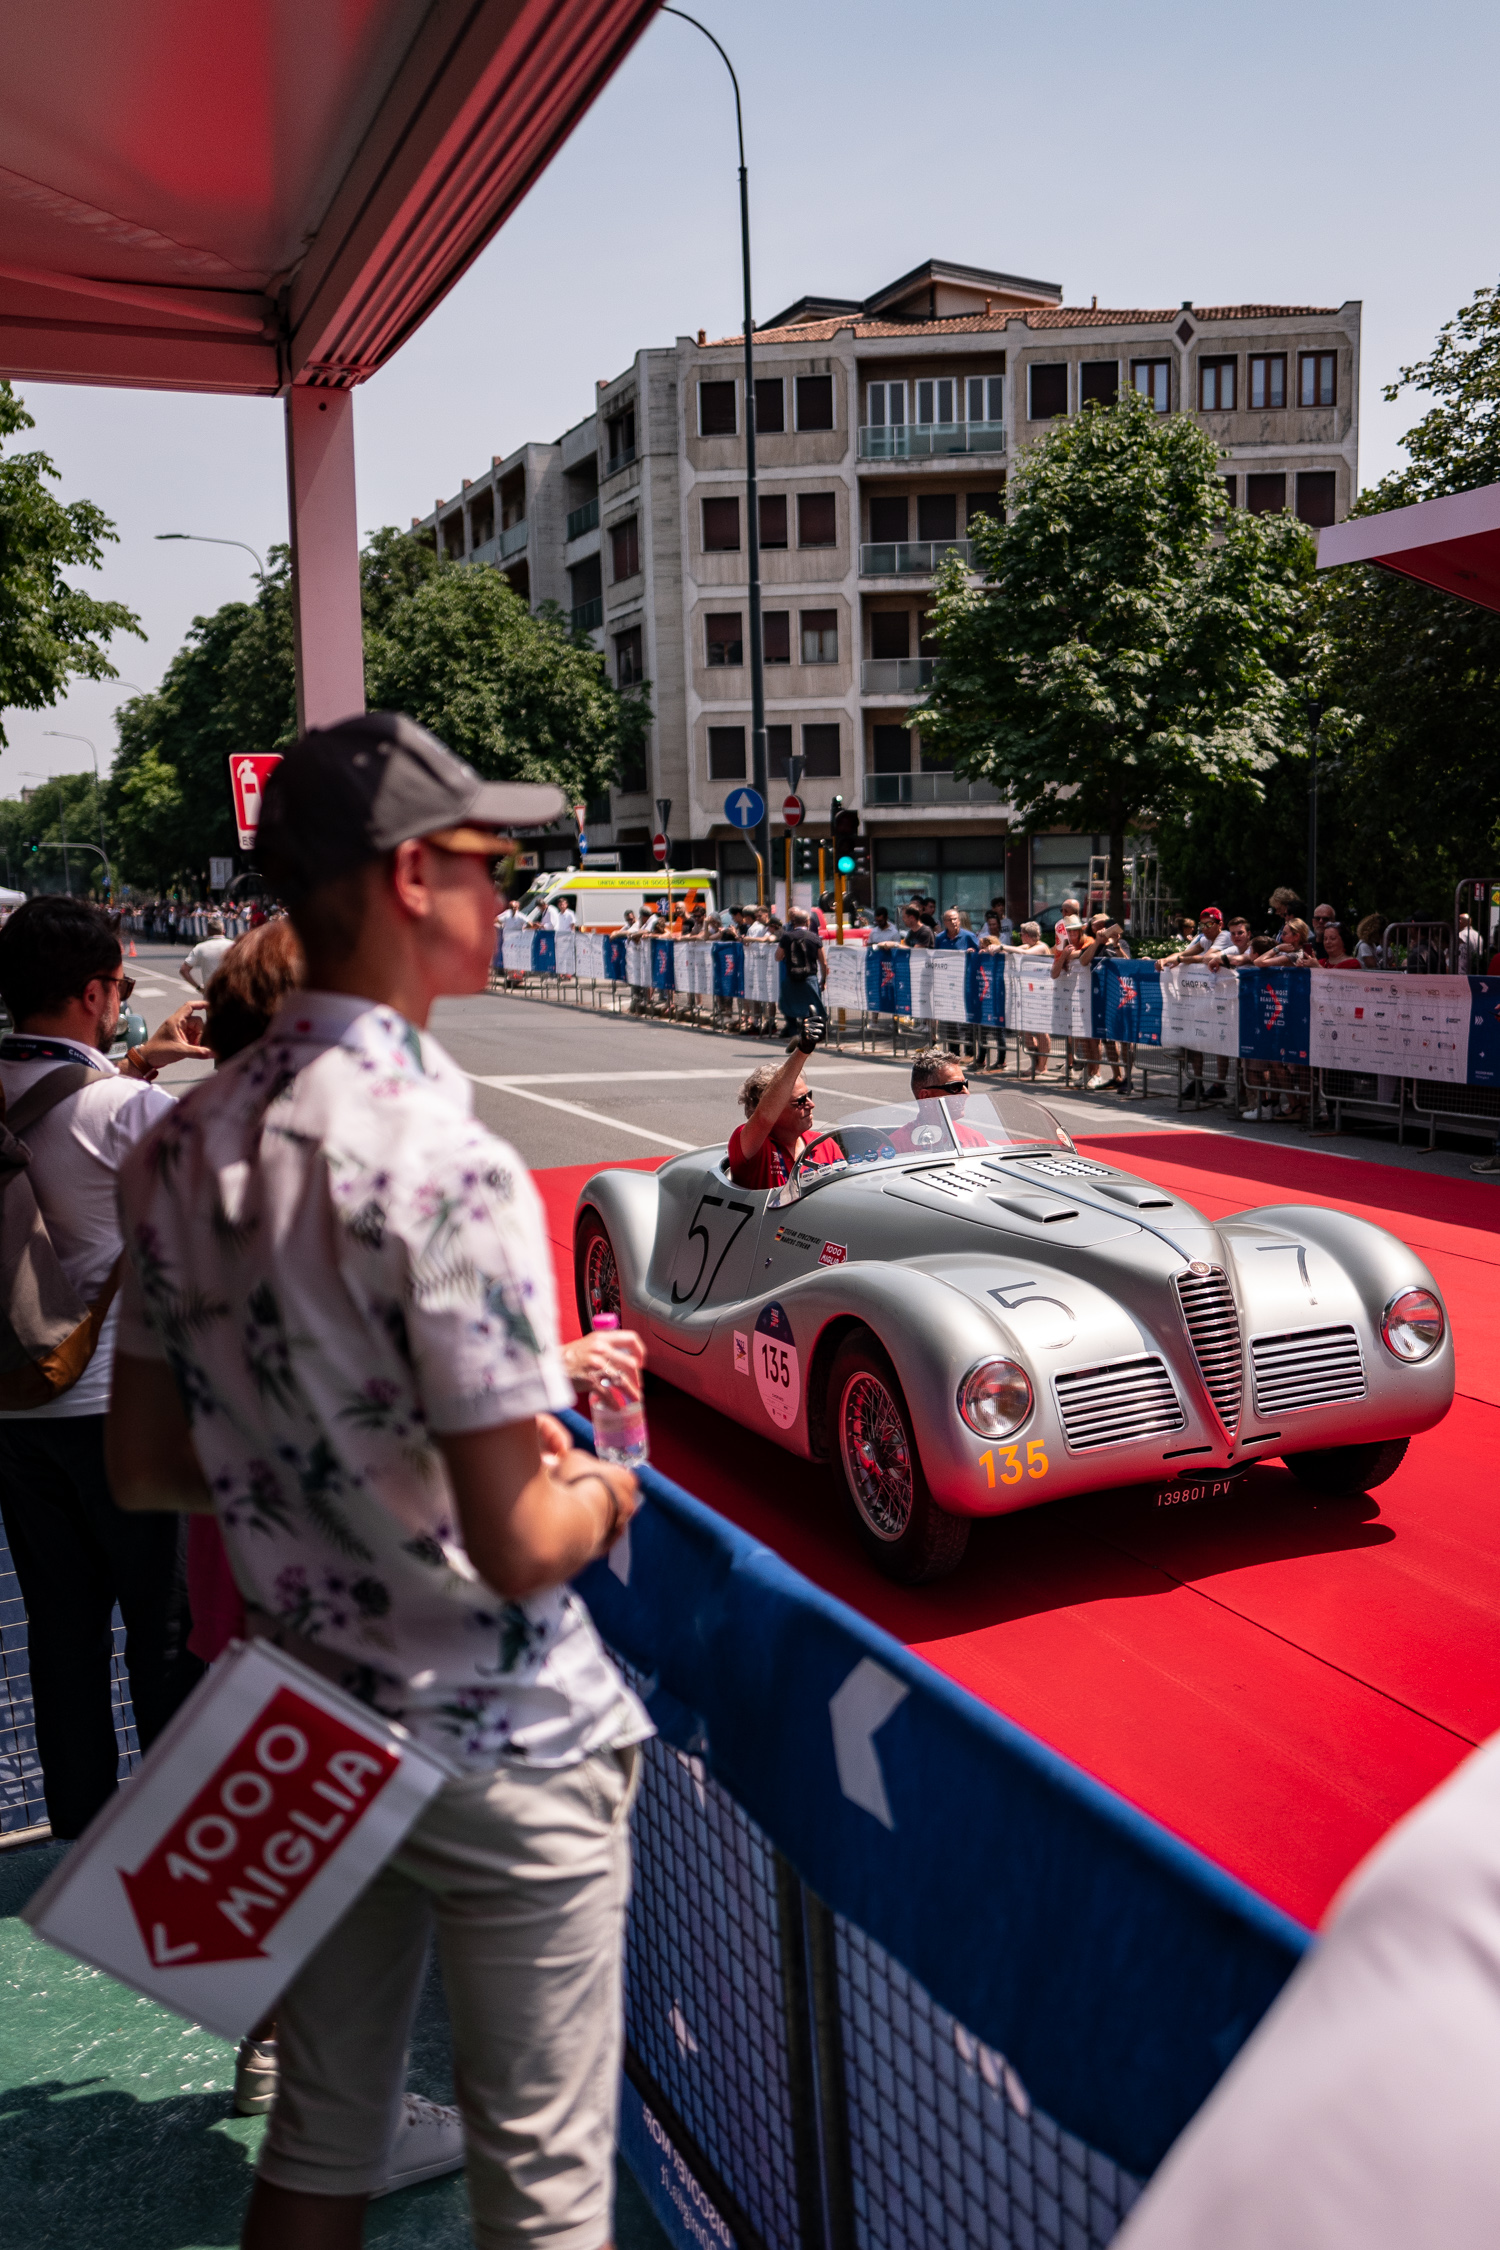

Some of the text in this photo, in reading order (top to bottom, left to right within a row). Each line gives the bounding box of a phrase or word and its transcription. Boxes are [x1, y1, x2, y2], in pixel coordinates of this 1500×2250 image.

[670, 1194, 755, 1312] 57
[826, 1245, 843, 1256] 1000
[1256, 1245, 1318, 1306] 7
[987, 1281, 1076, 1350] 5
[761, 1343, 790, 1388] 135
[978, 1438, 1049, 1489] 135
[1158, 1481, 1231, 1507] 139801 PV
[165, 1723, 309, 1883] 1000
[216, 1750, 384, 1938] MIGLIA
